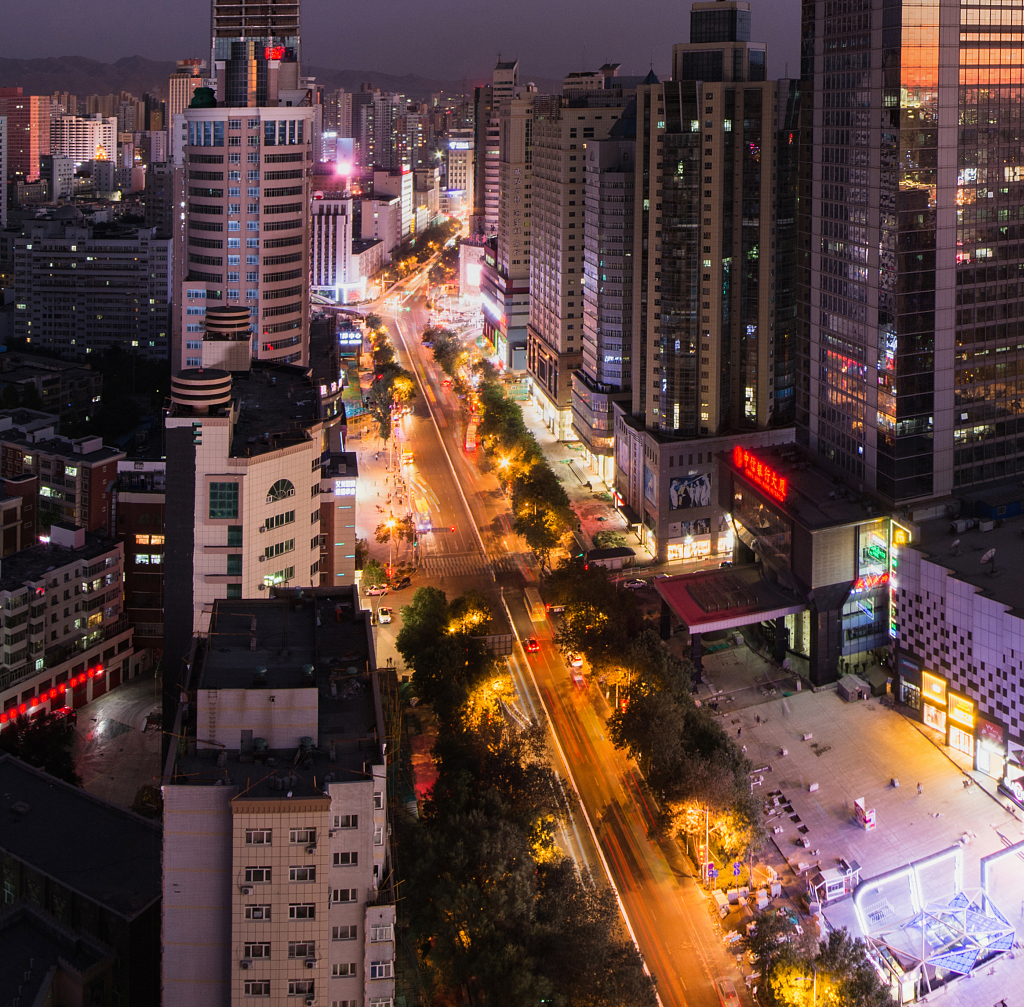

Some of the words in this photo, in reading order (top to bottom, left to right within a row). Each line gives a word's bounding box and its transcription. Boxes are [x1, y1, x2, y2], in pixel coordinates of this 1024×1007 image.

[743, 450, 787, 497] 中信银行大厦
